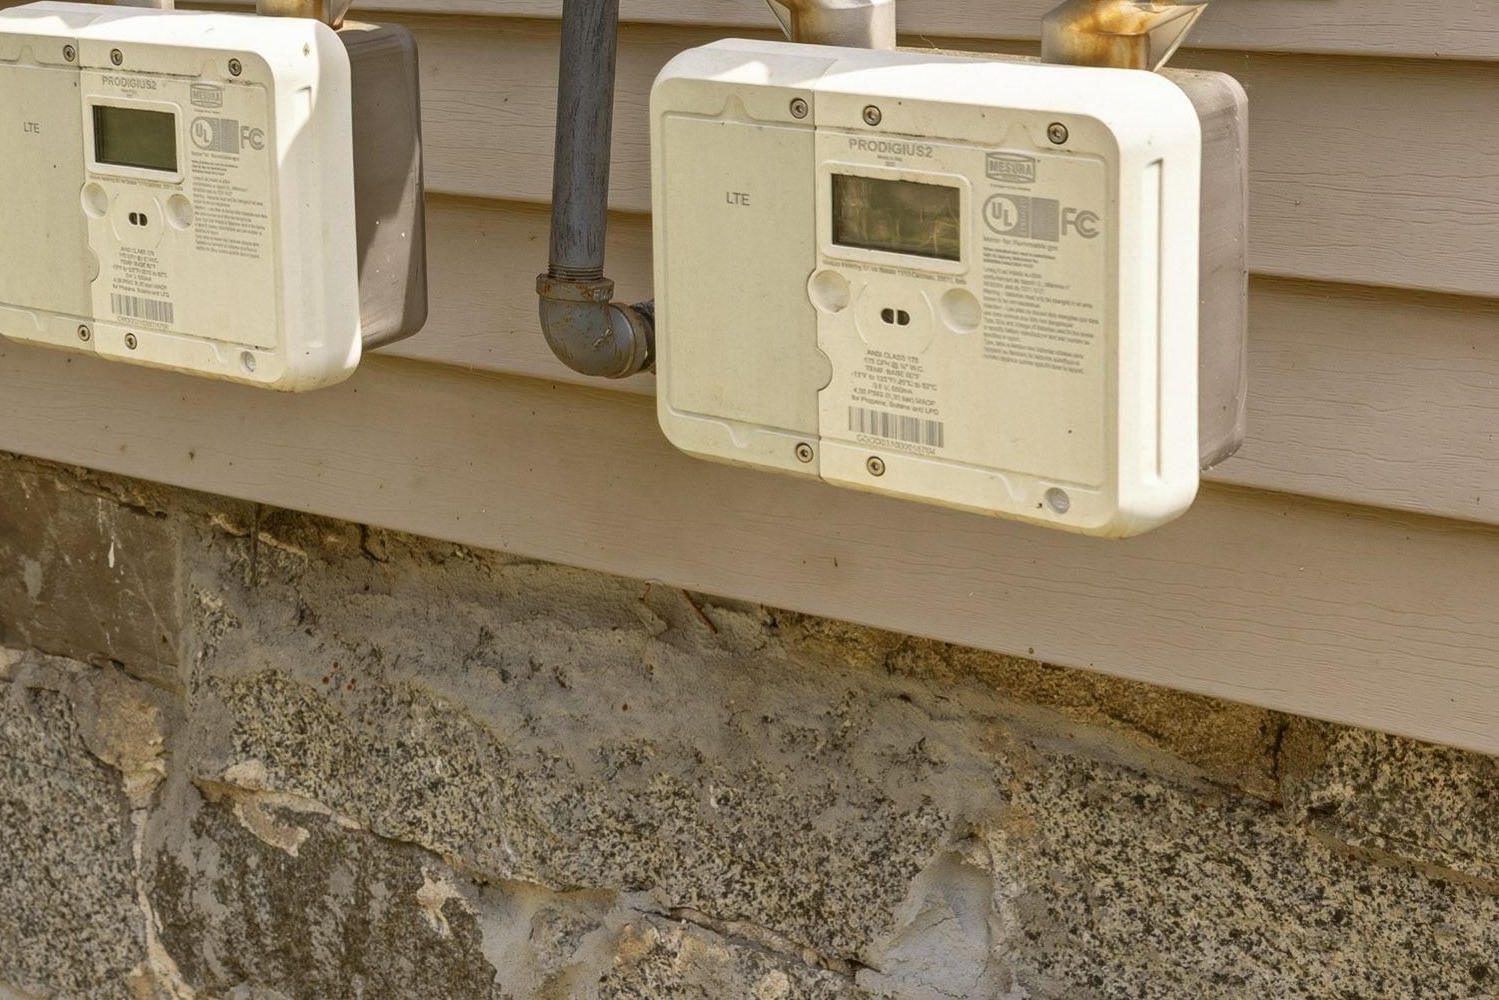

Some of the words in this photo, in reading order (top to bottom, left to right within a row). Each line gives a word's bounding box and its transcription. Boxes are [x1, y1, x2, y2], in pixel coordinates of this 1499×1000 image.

[102, 75, 158, 90] PRODIGIUS2
[23, 121, 40, 134] LTE
[848, 138, 934, 158] PRODIGIUS2
[726, 191, 751, 206] LTE
